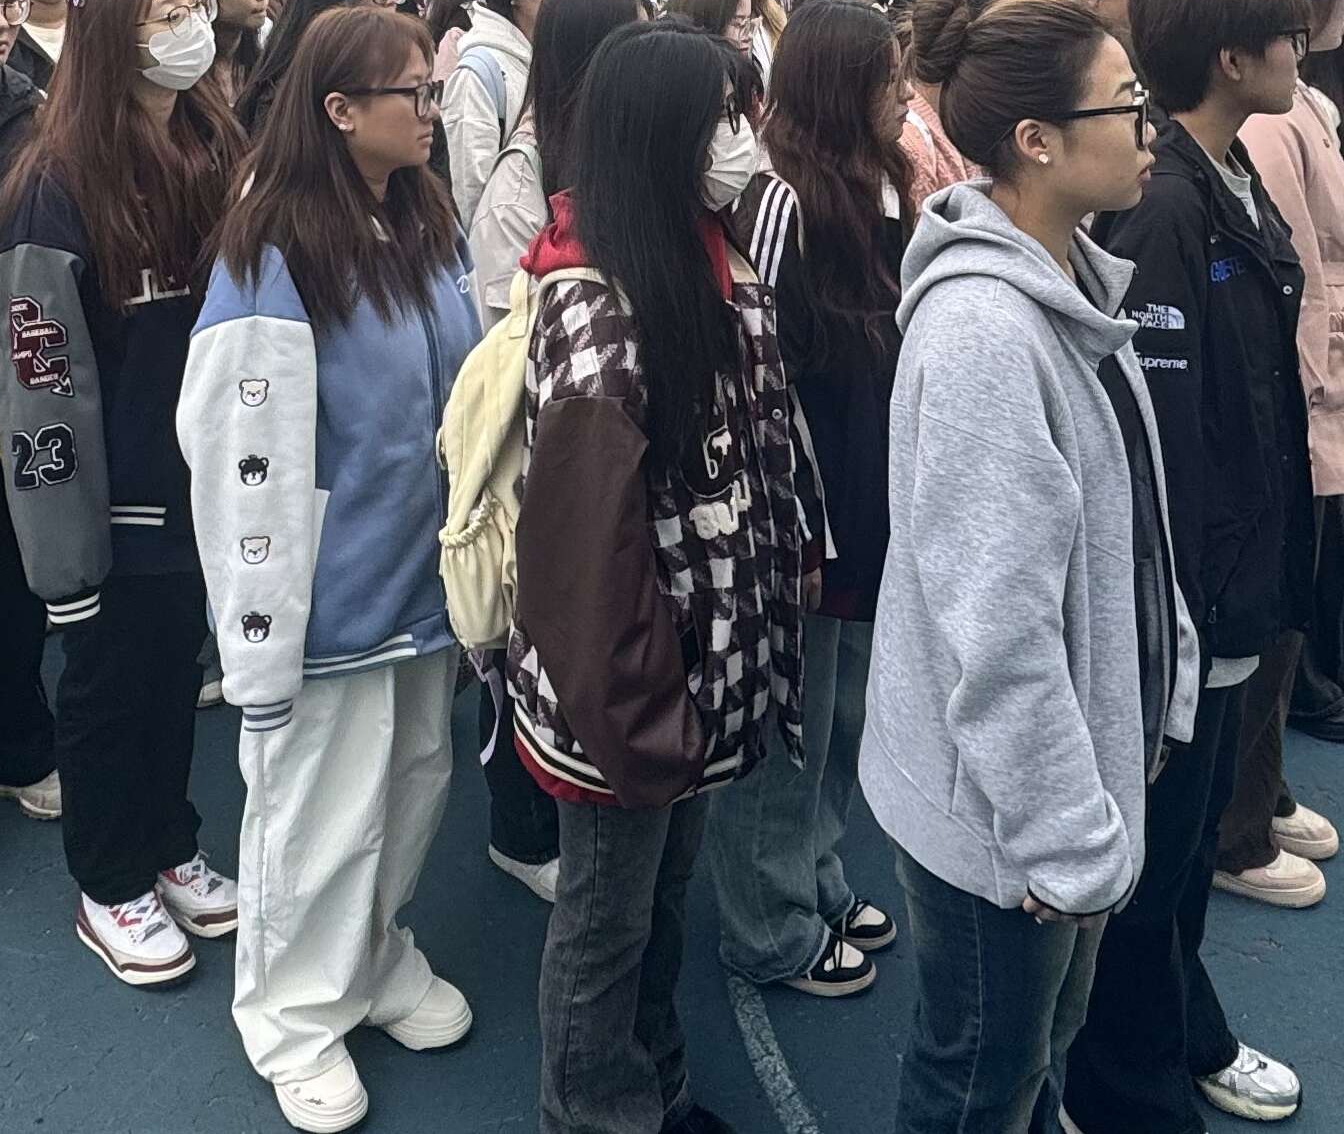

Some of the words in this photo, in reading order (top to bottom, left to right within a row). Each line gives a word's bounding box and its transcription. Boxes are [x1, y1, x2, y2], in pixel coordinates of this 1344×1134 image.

[1145, 303, 1168, 313] THE
[1131, 309, 1168, 324] NORTH
[12, 422, 78, 491] 23
